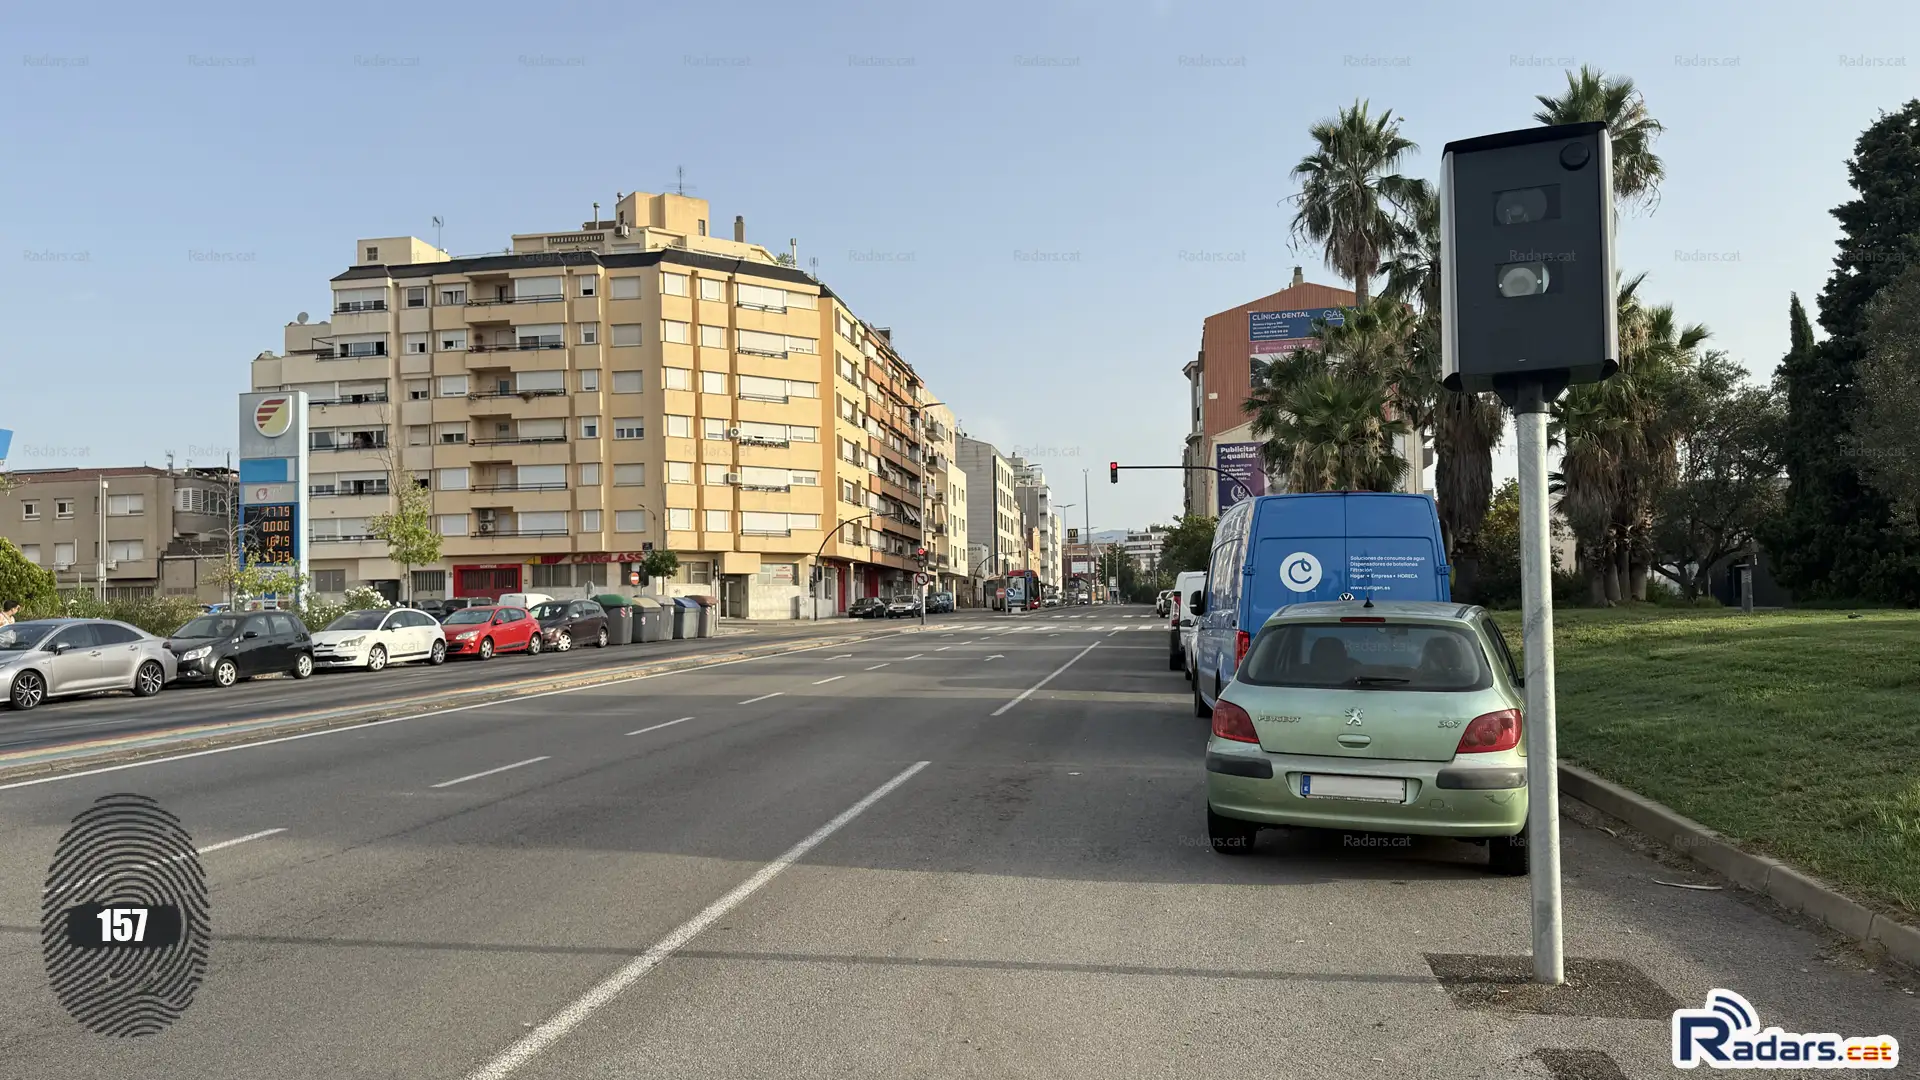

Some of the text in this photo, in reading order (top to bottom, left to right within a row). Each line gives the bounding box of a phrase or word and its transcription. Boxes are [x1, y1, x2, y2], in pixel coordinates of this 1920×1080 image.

[1252, 312, 1280, 321] CLÍNICA
[571, 553, 643, 563] CARGLASS
[1258, 715, 1301, 723] PEUGEOT
[1438, 720, 1460, 728] 307
